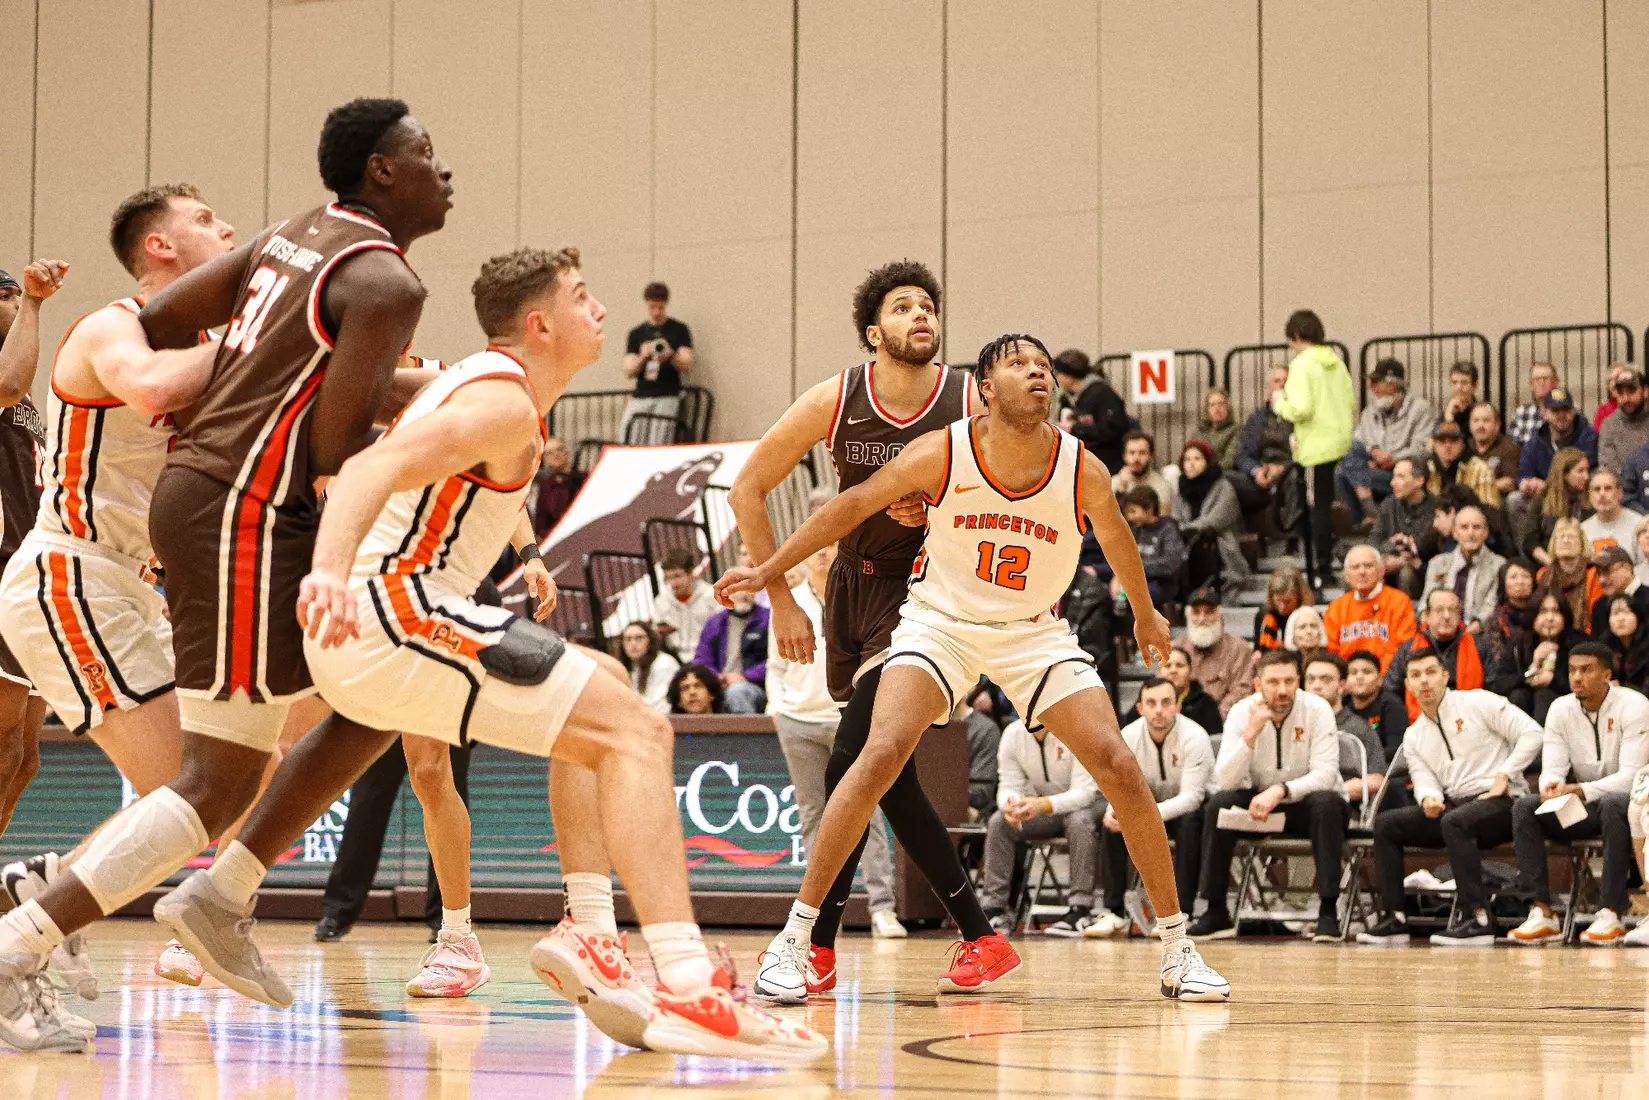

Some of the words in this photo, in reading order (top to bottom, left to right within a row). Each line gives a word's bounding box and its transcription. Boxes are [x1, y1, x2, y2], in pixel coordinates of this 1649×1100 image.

[223, 264, 292, 356] 31
[1140, 360, 1166, 394] N
[954, 513, 1058, 545] PRINCETON
[862, 559, 874, 575] B
[976, 541, 1031, 591] 12
[429, 621, 463, 654] P
[79, 660, 107, 694] P
[303, 832, 343, 862] BA
